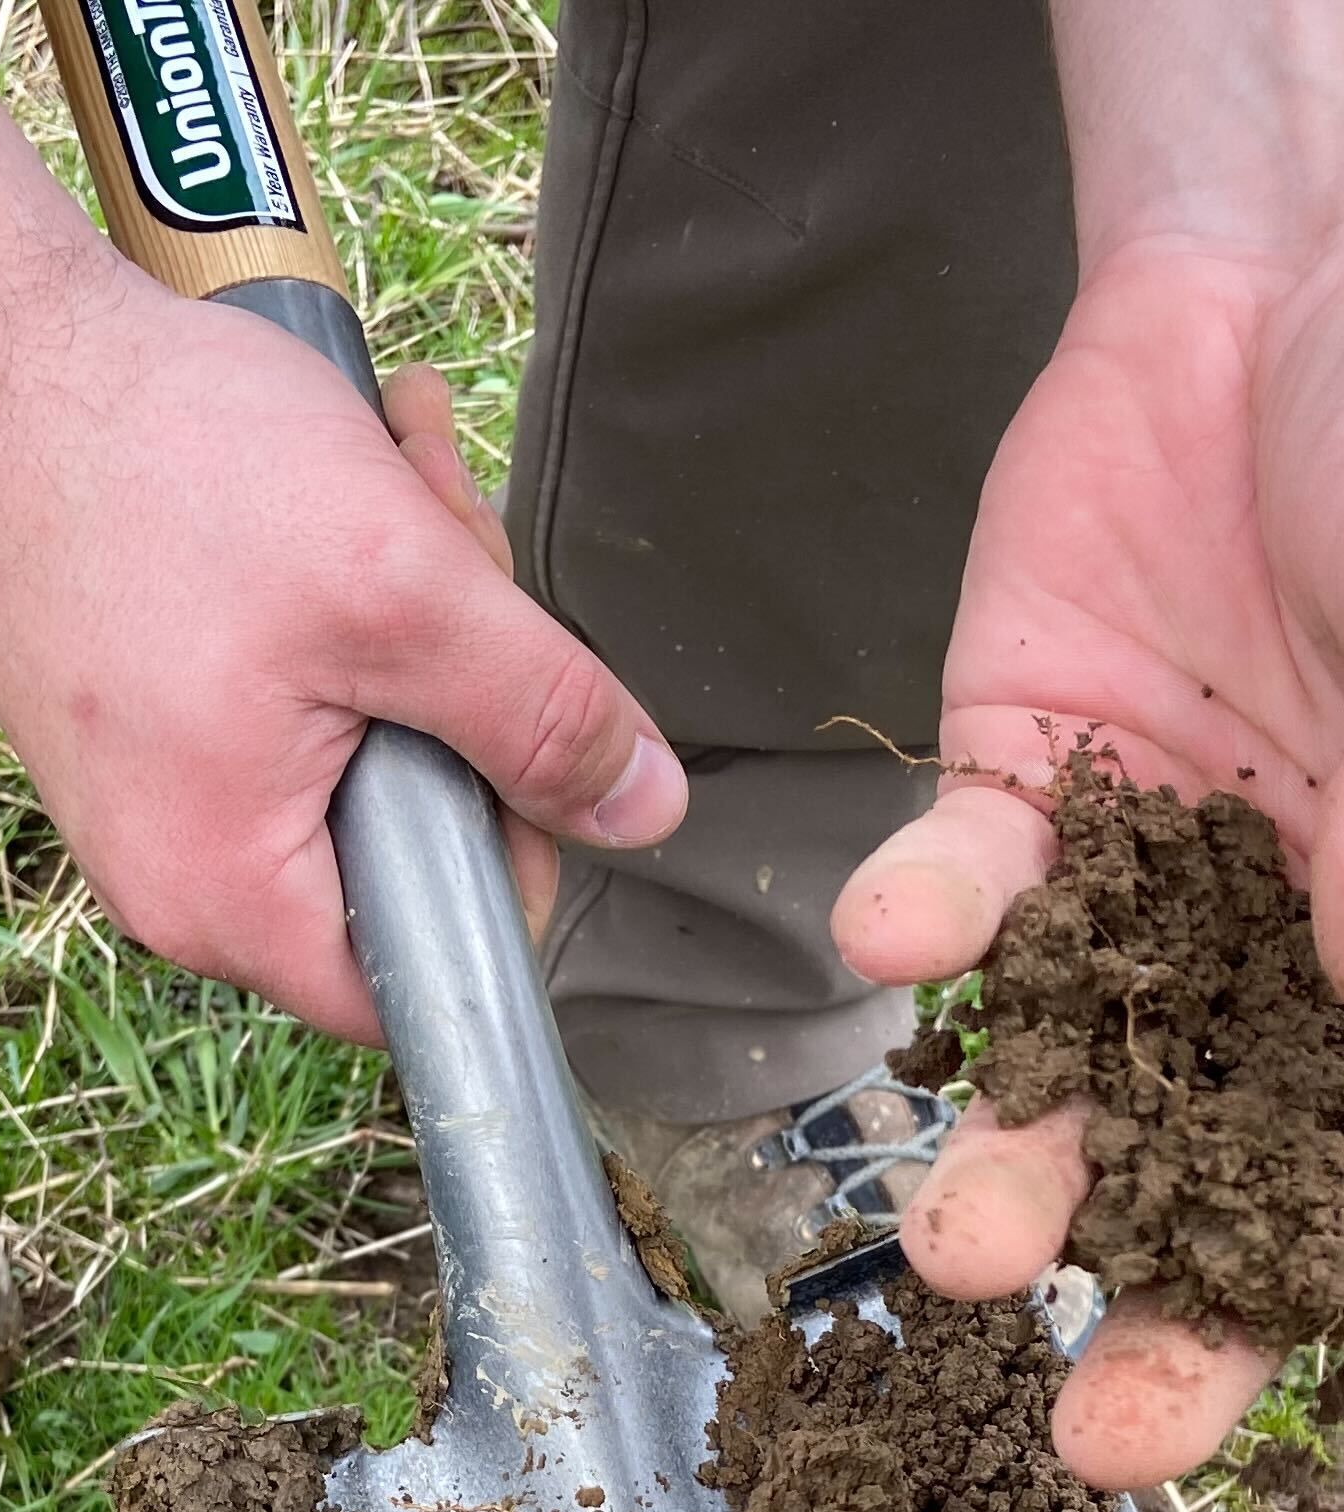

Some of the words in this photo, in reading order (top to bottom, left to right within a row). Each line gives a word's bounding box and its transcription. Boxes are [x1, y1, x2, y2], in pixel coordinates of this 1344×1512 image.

[97, 20, 114, 50] AMES
[105, 50, 120, 73] THE
[123, 0, 231, 190] UnionT
[238, 85, 273, 159] Warranty
[263, 162, 285, 197] Year
[271, 199, 288, 213] 5
